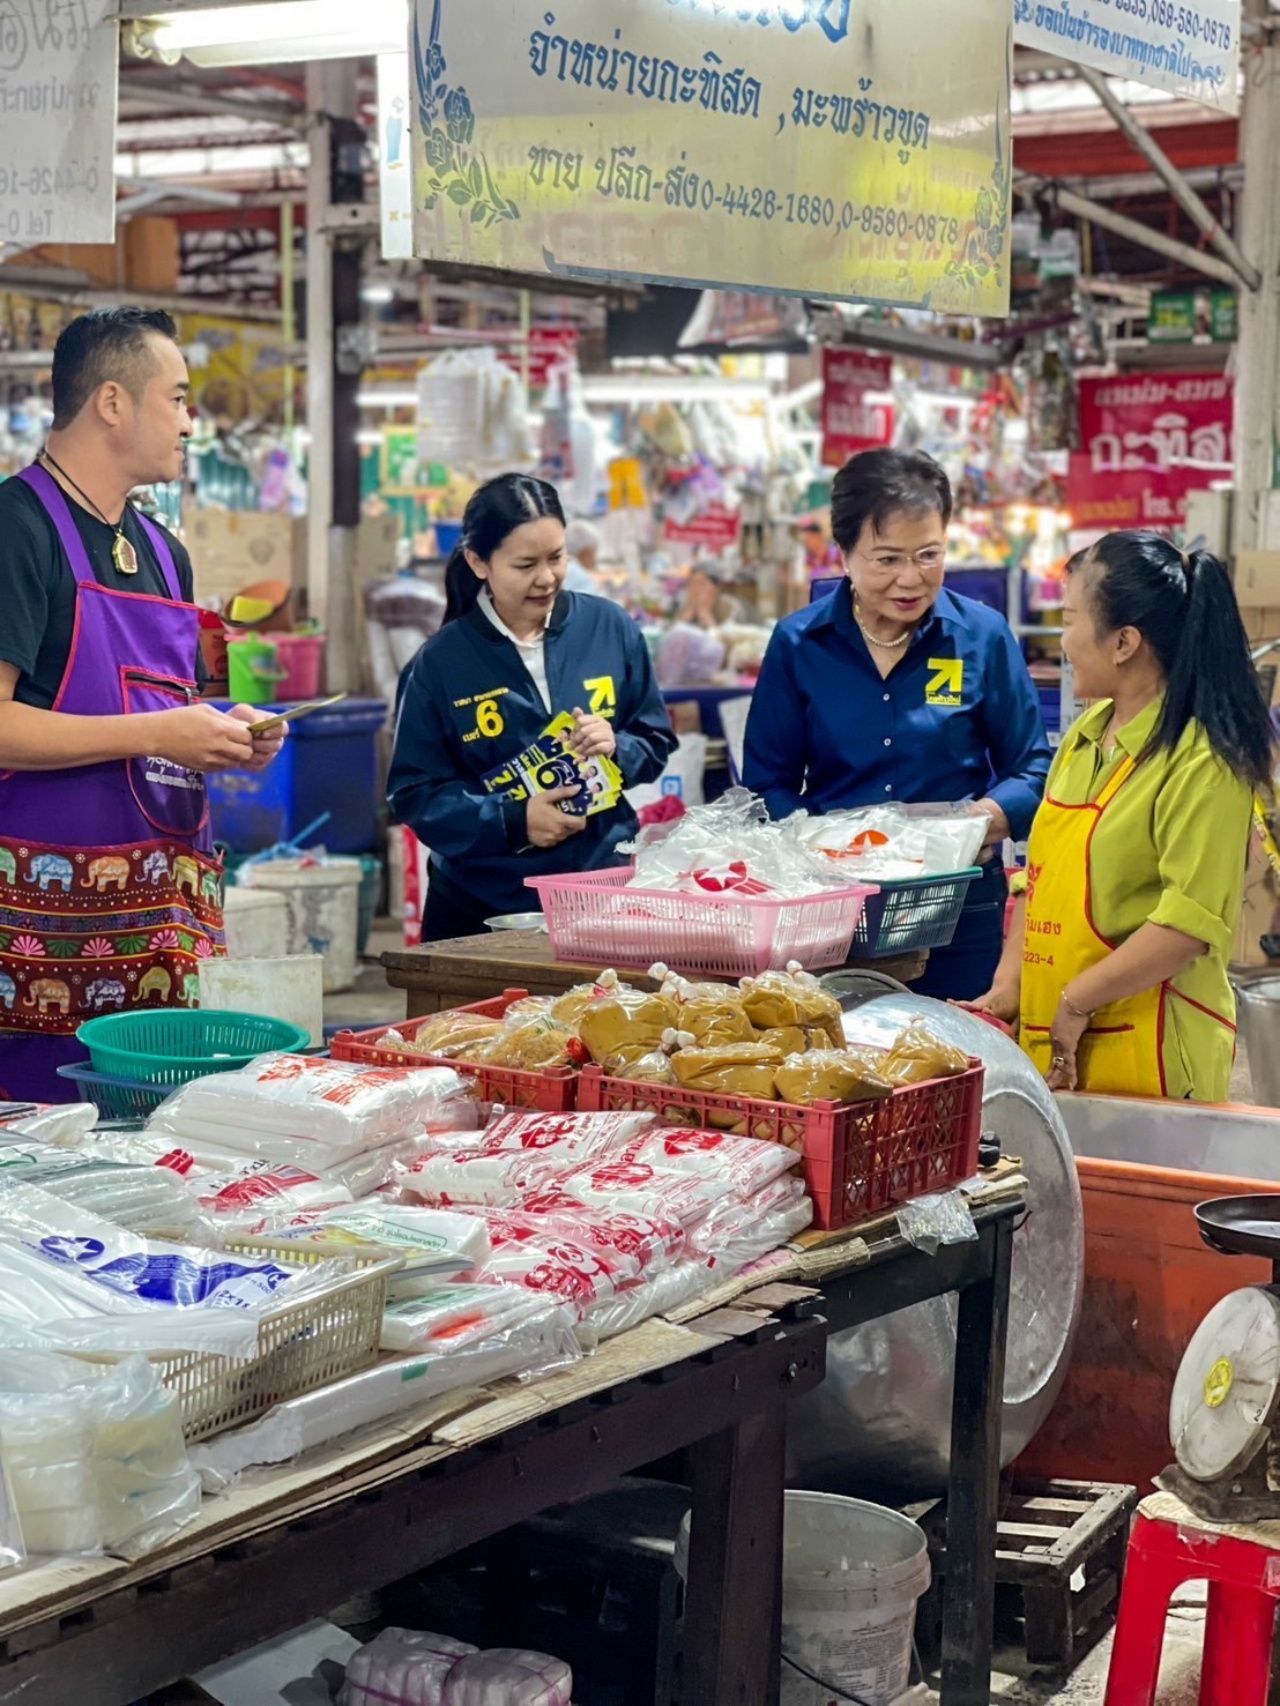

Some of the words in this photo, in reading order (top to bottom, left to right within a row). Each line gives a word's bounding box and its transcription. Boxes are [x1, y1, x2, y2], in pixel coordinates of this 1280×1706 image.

[528, 12, 762, 119] จำหน่ายกะทิสด
[527, 144, 583, 191] ขาย
[1089, 413, 1233, 474] กะทิส
[476, 700, 504, 738] 6
